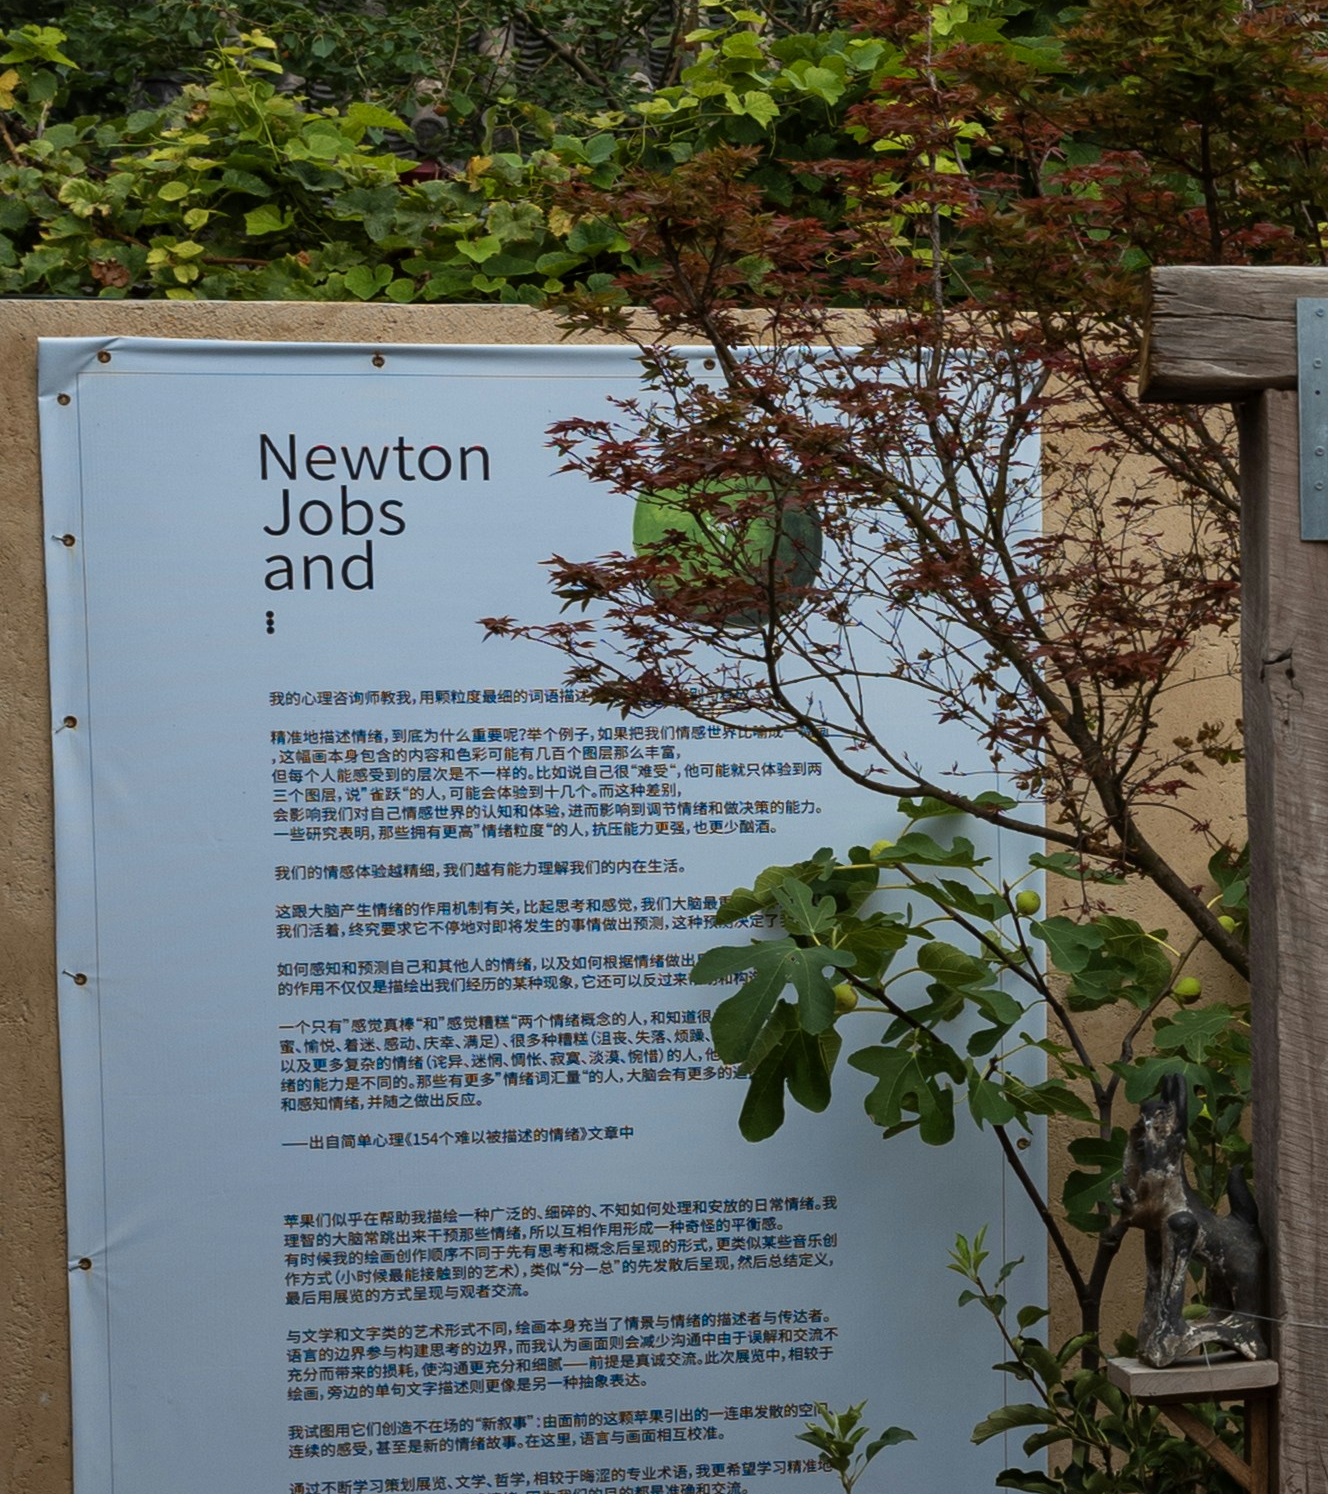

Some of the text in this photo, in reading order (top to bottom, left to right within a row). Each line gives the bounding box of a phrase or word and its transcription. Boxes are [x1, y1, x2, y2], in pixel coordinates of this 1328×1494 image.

[260, 434, 490, 481] Newton
[263, 485, 406, 536] Jobs
[264, 540, 374, 590] and
